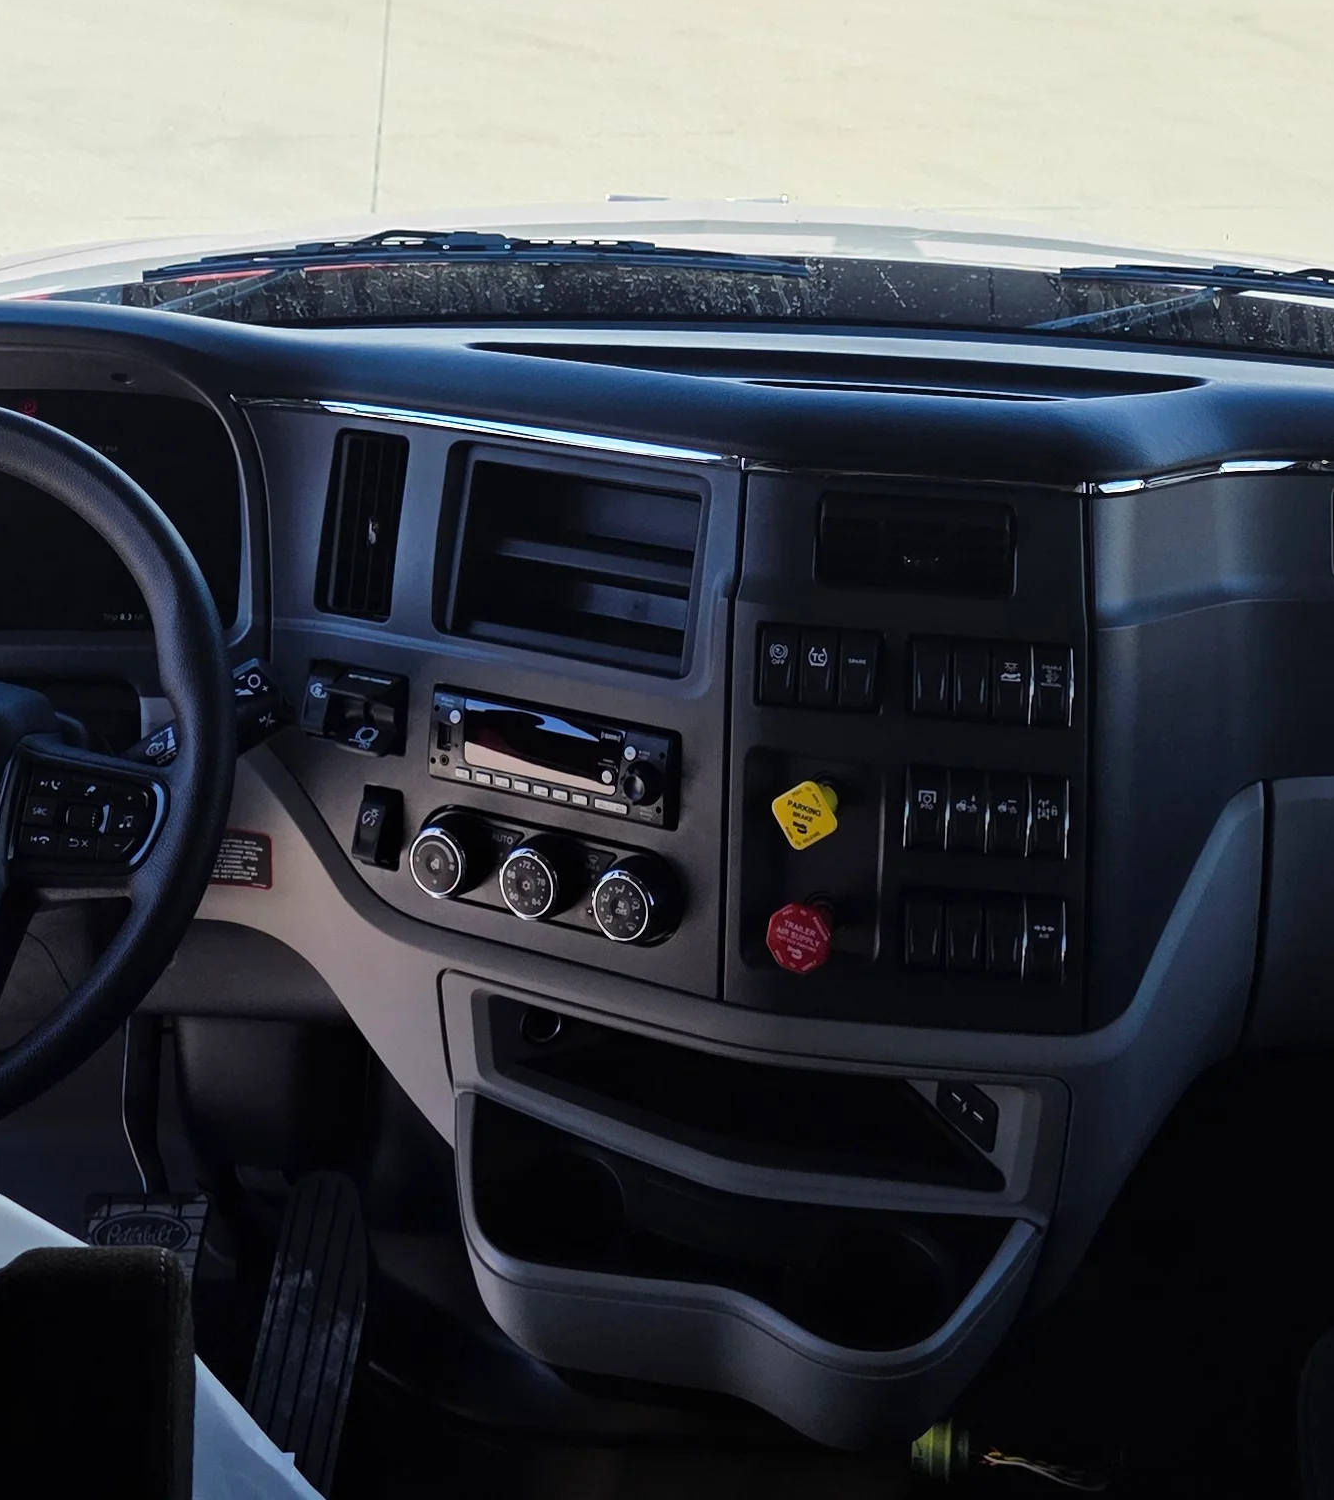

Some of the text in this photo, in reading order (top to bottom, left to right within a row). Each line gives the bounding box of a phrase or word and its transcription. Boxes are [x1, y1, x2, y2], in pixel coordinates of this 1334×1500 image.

[771, 658, 785, 666] OFF
[811, 653, 825, 663] TC
[32, 807, 47, 816] SRC
[787, 800, 821, 817] PARKING
[492, 831, 514, 845] AUTO
[522, 860, 531, 870] 72
[107, 1223, 174, 1246] Peterbilt
